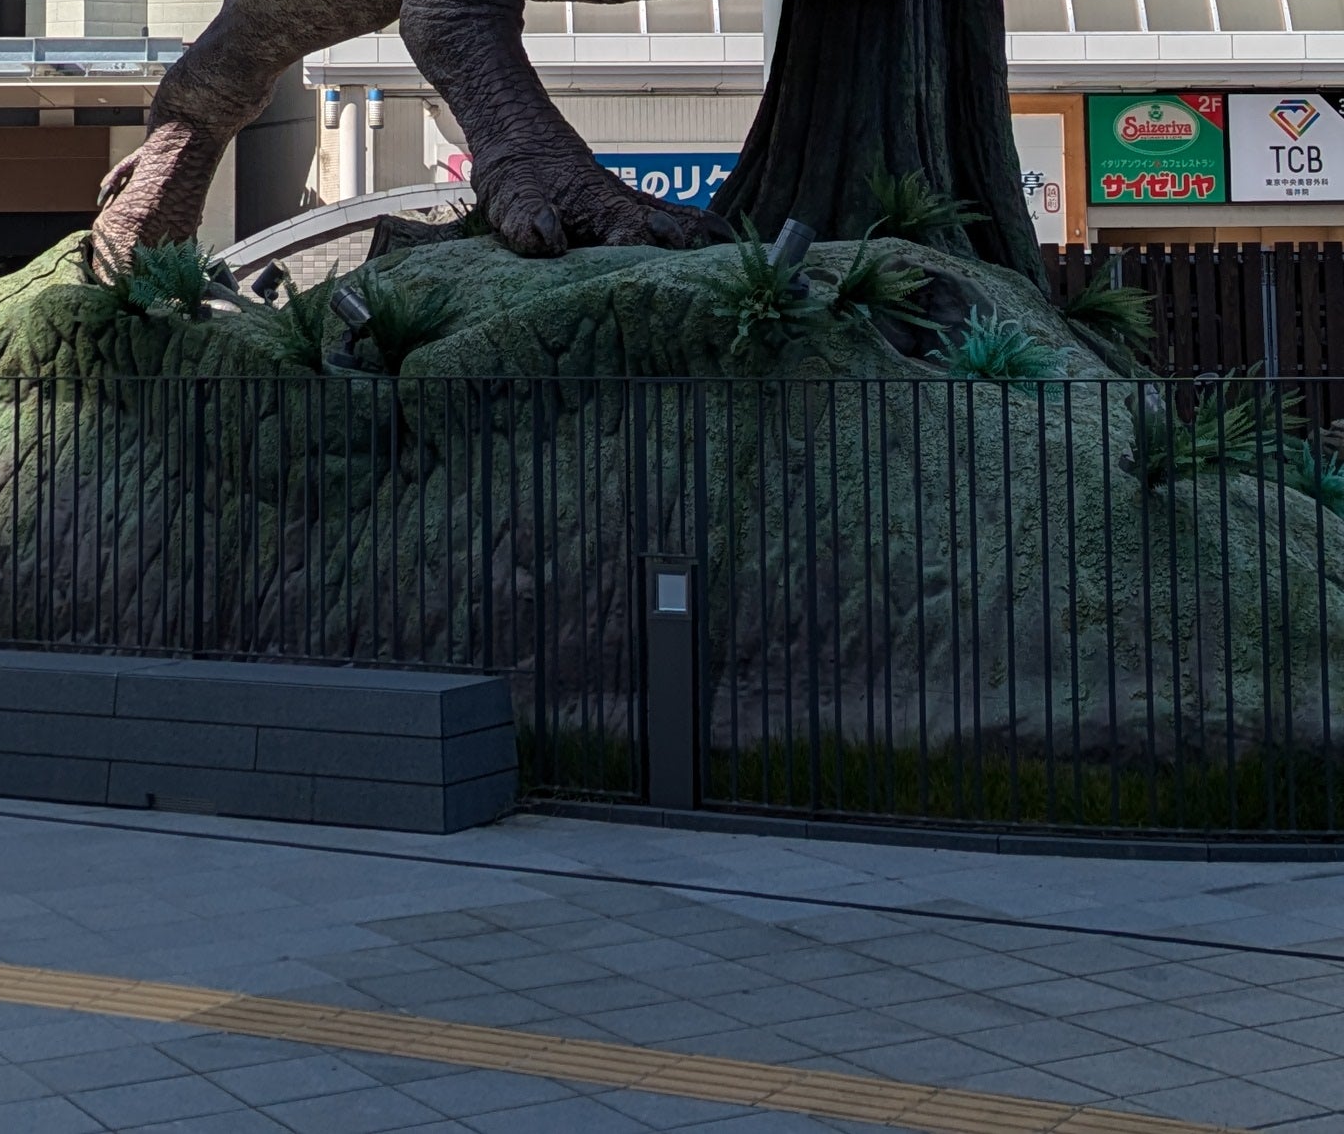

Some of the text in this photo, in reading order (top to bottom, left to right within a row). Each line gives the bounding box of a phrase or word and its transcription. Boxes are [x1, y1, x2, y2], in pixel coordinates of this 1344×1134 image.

[1197, 95, 1223, 113] 2F
[1121, 115, 1193, 141] Saizeriya
[1269, 146, 1323, 174] TCB
[1101, 171, 1216, 200] サイゼリヤ
